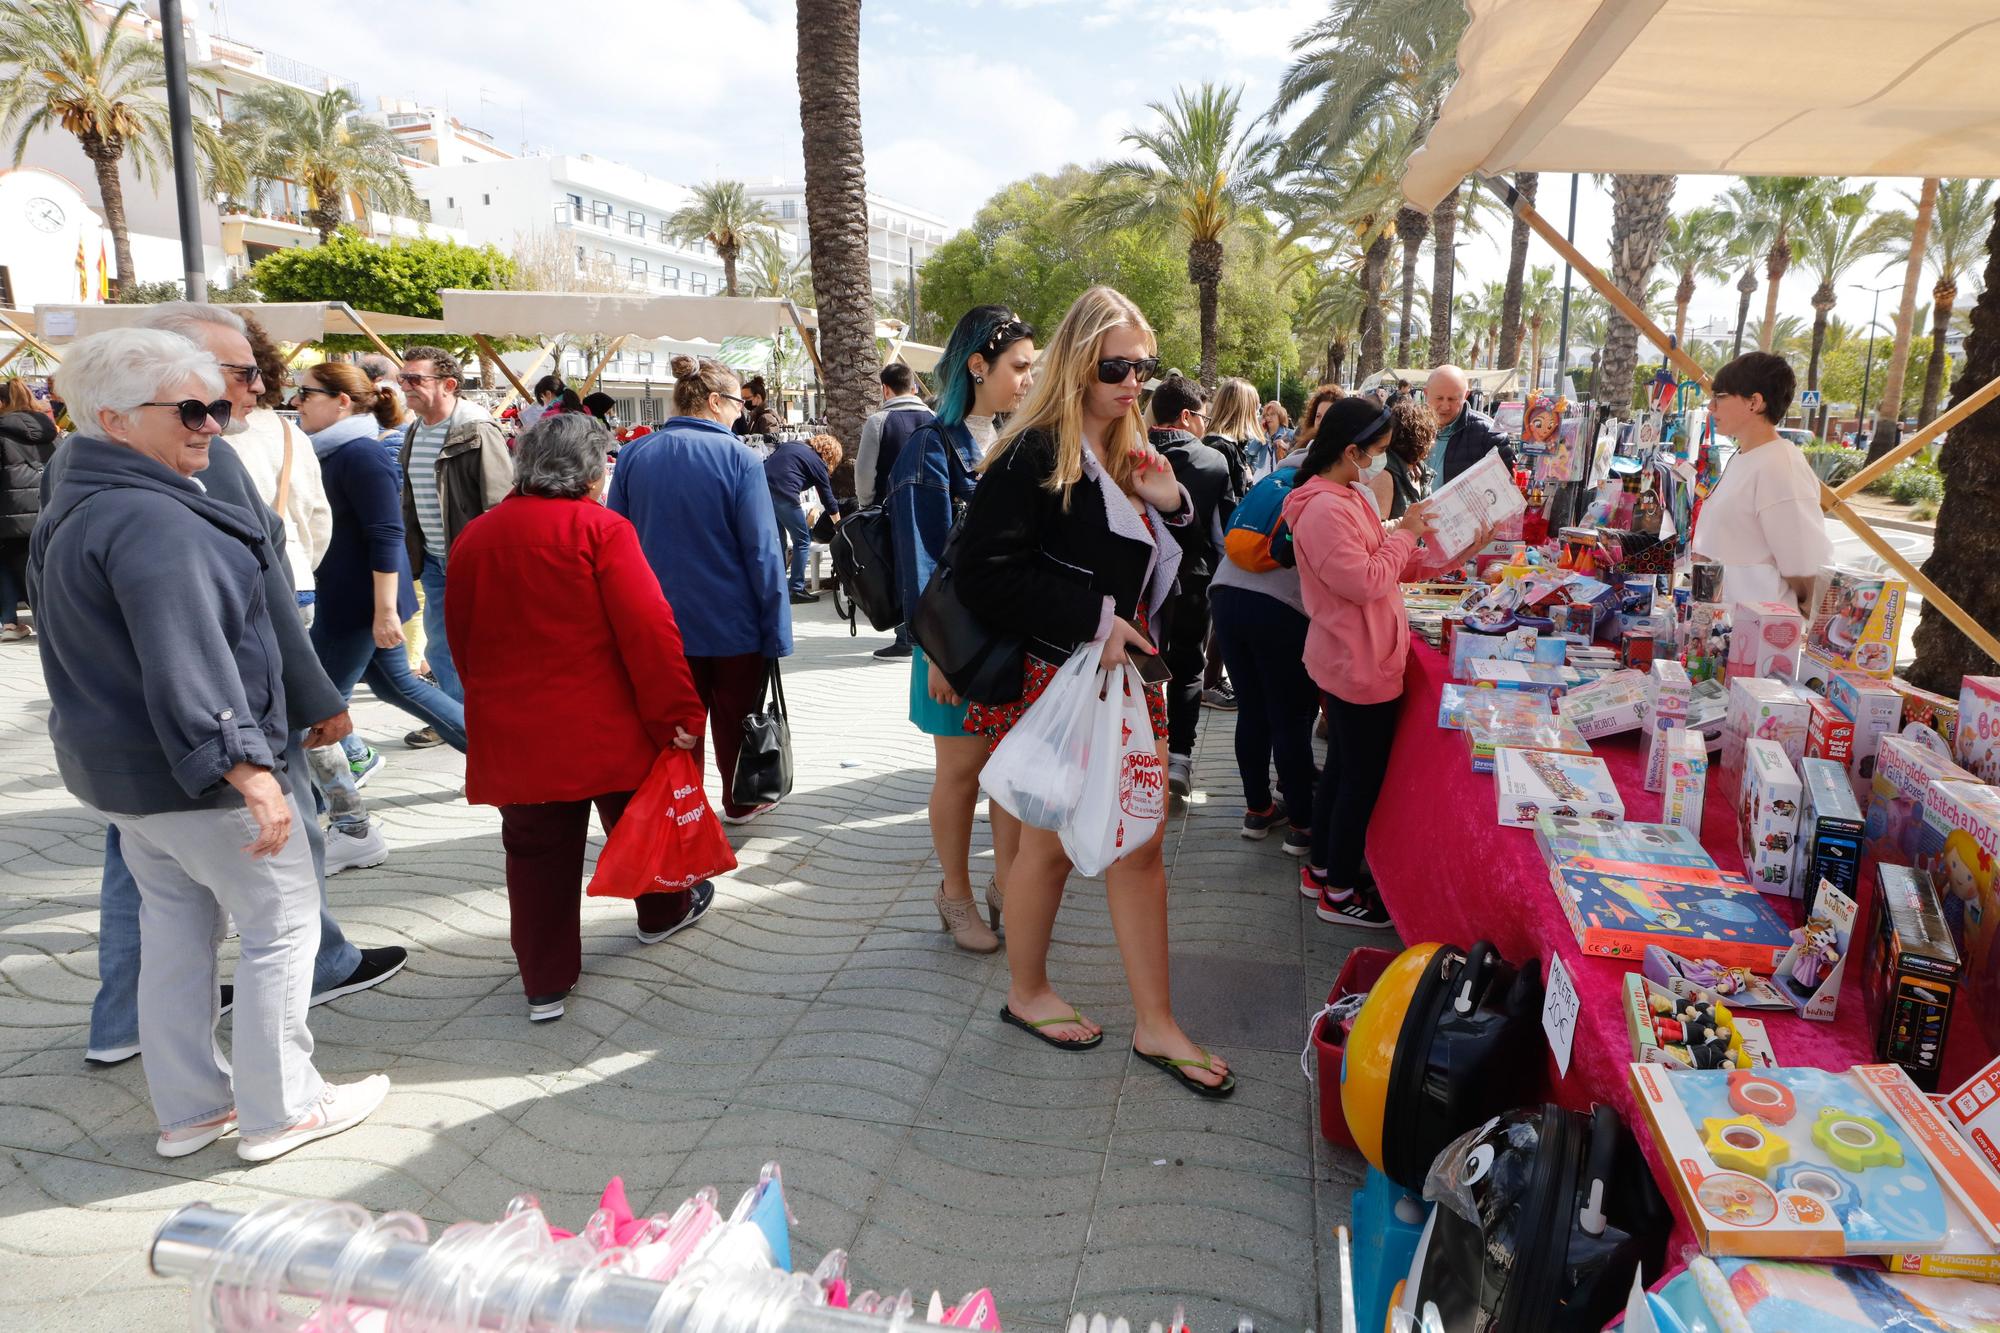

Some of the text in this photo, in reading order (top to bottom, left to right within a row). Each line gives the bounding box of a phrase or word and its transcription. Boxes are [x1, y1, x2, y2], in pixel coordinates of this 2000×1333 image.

[1882, 590, 1898, 640] Barriguitas
[1594, 716, 1617, 731] ROBOT
[1886, 764, 1925, 803] Gift Boxes
[1927, 786, 1960, 827] Stitch
[1961, 812, 1969, 828] a
[1806, 1006, 1834, 1018] budkins
[1975, 1132, 1988, 1149] Love
[1797, 1205, 1814, 1214] 3
[1931, 1253, 1986, 1268] Dynamic
